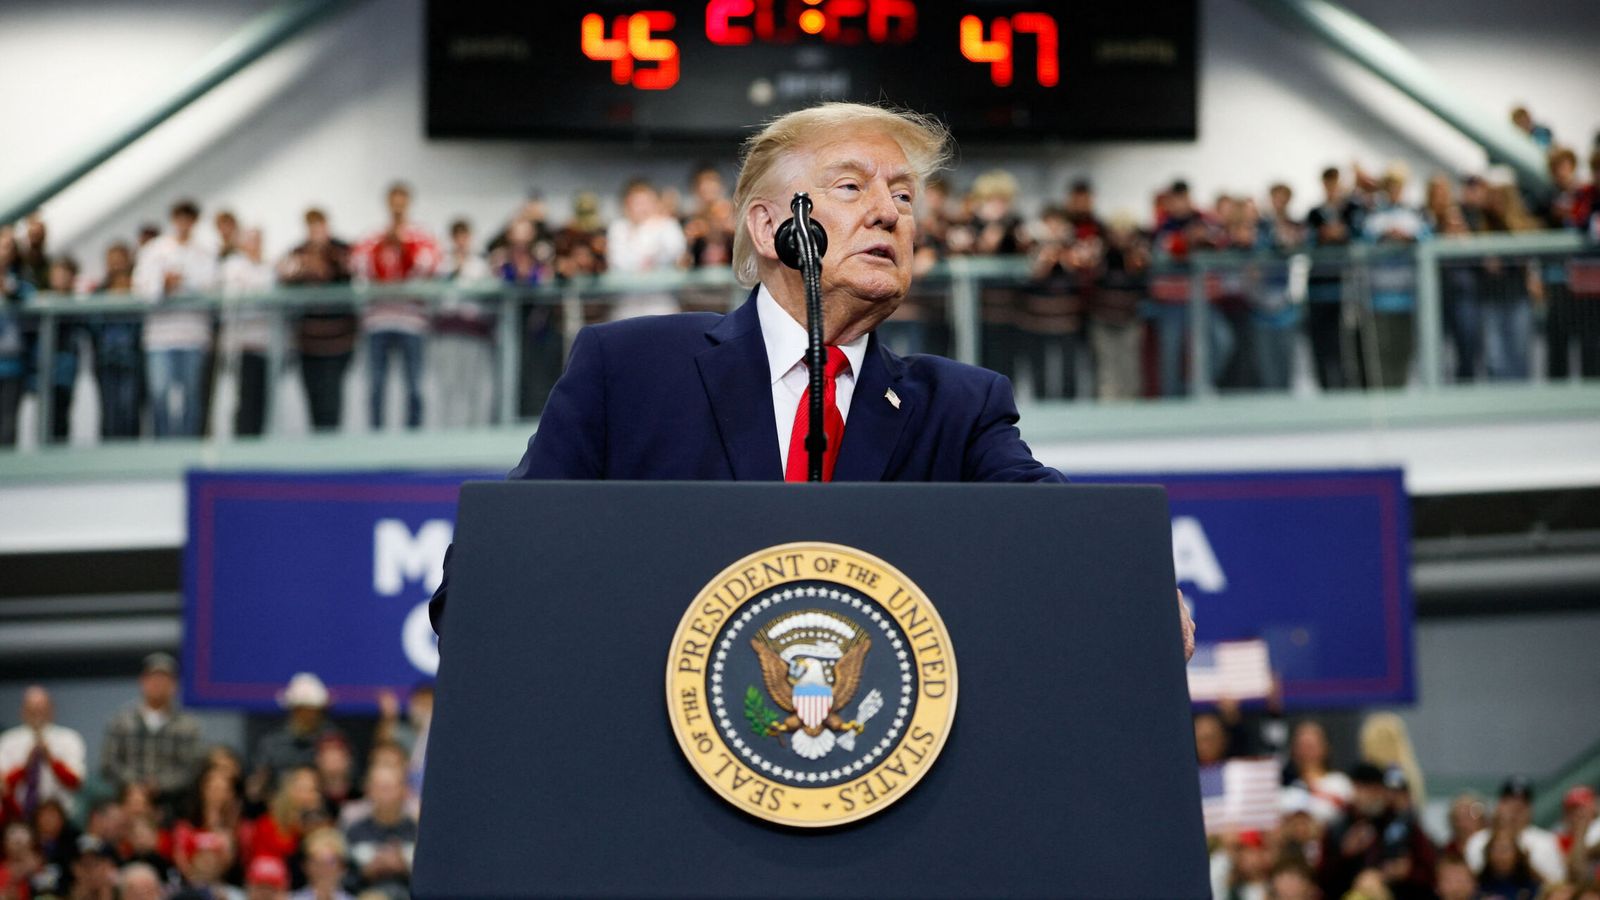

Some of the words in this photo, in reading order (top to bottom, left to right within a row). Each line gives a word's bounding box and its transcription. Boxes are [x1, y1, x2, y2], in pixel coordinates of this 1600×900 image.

[581, 10, 680, 90] 45
[960, 12, 1059, 88] 47
[813, 557, 840, 573] OF
[846, 563, 880, 589] THE
[678, 554, 804, 675] PRESIDENT
[886, 587, 947, 699] UNITED
[682, 686, 701, 725] THE
[691, 725, 714, 756] OF
[837, 726, 935, 812] STATES
[713, 752, 785, 812] SEAL
